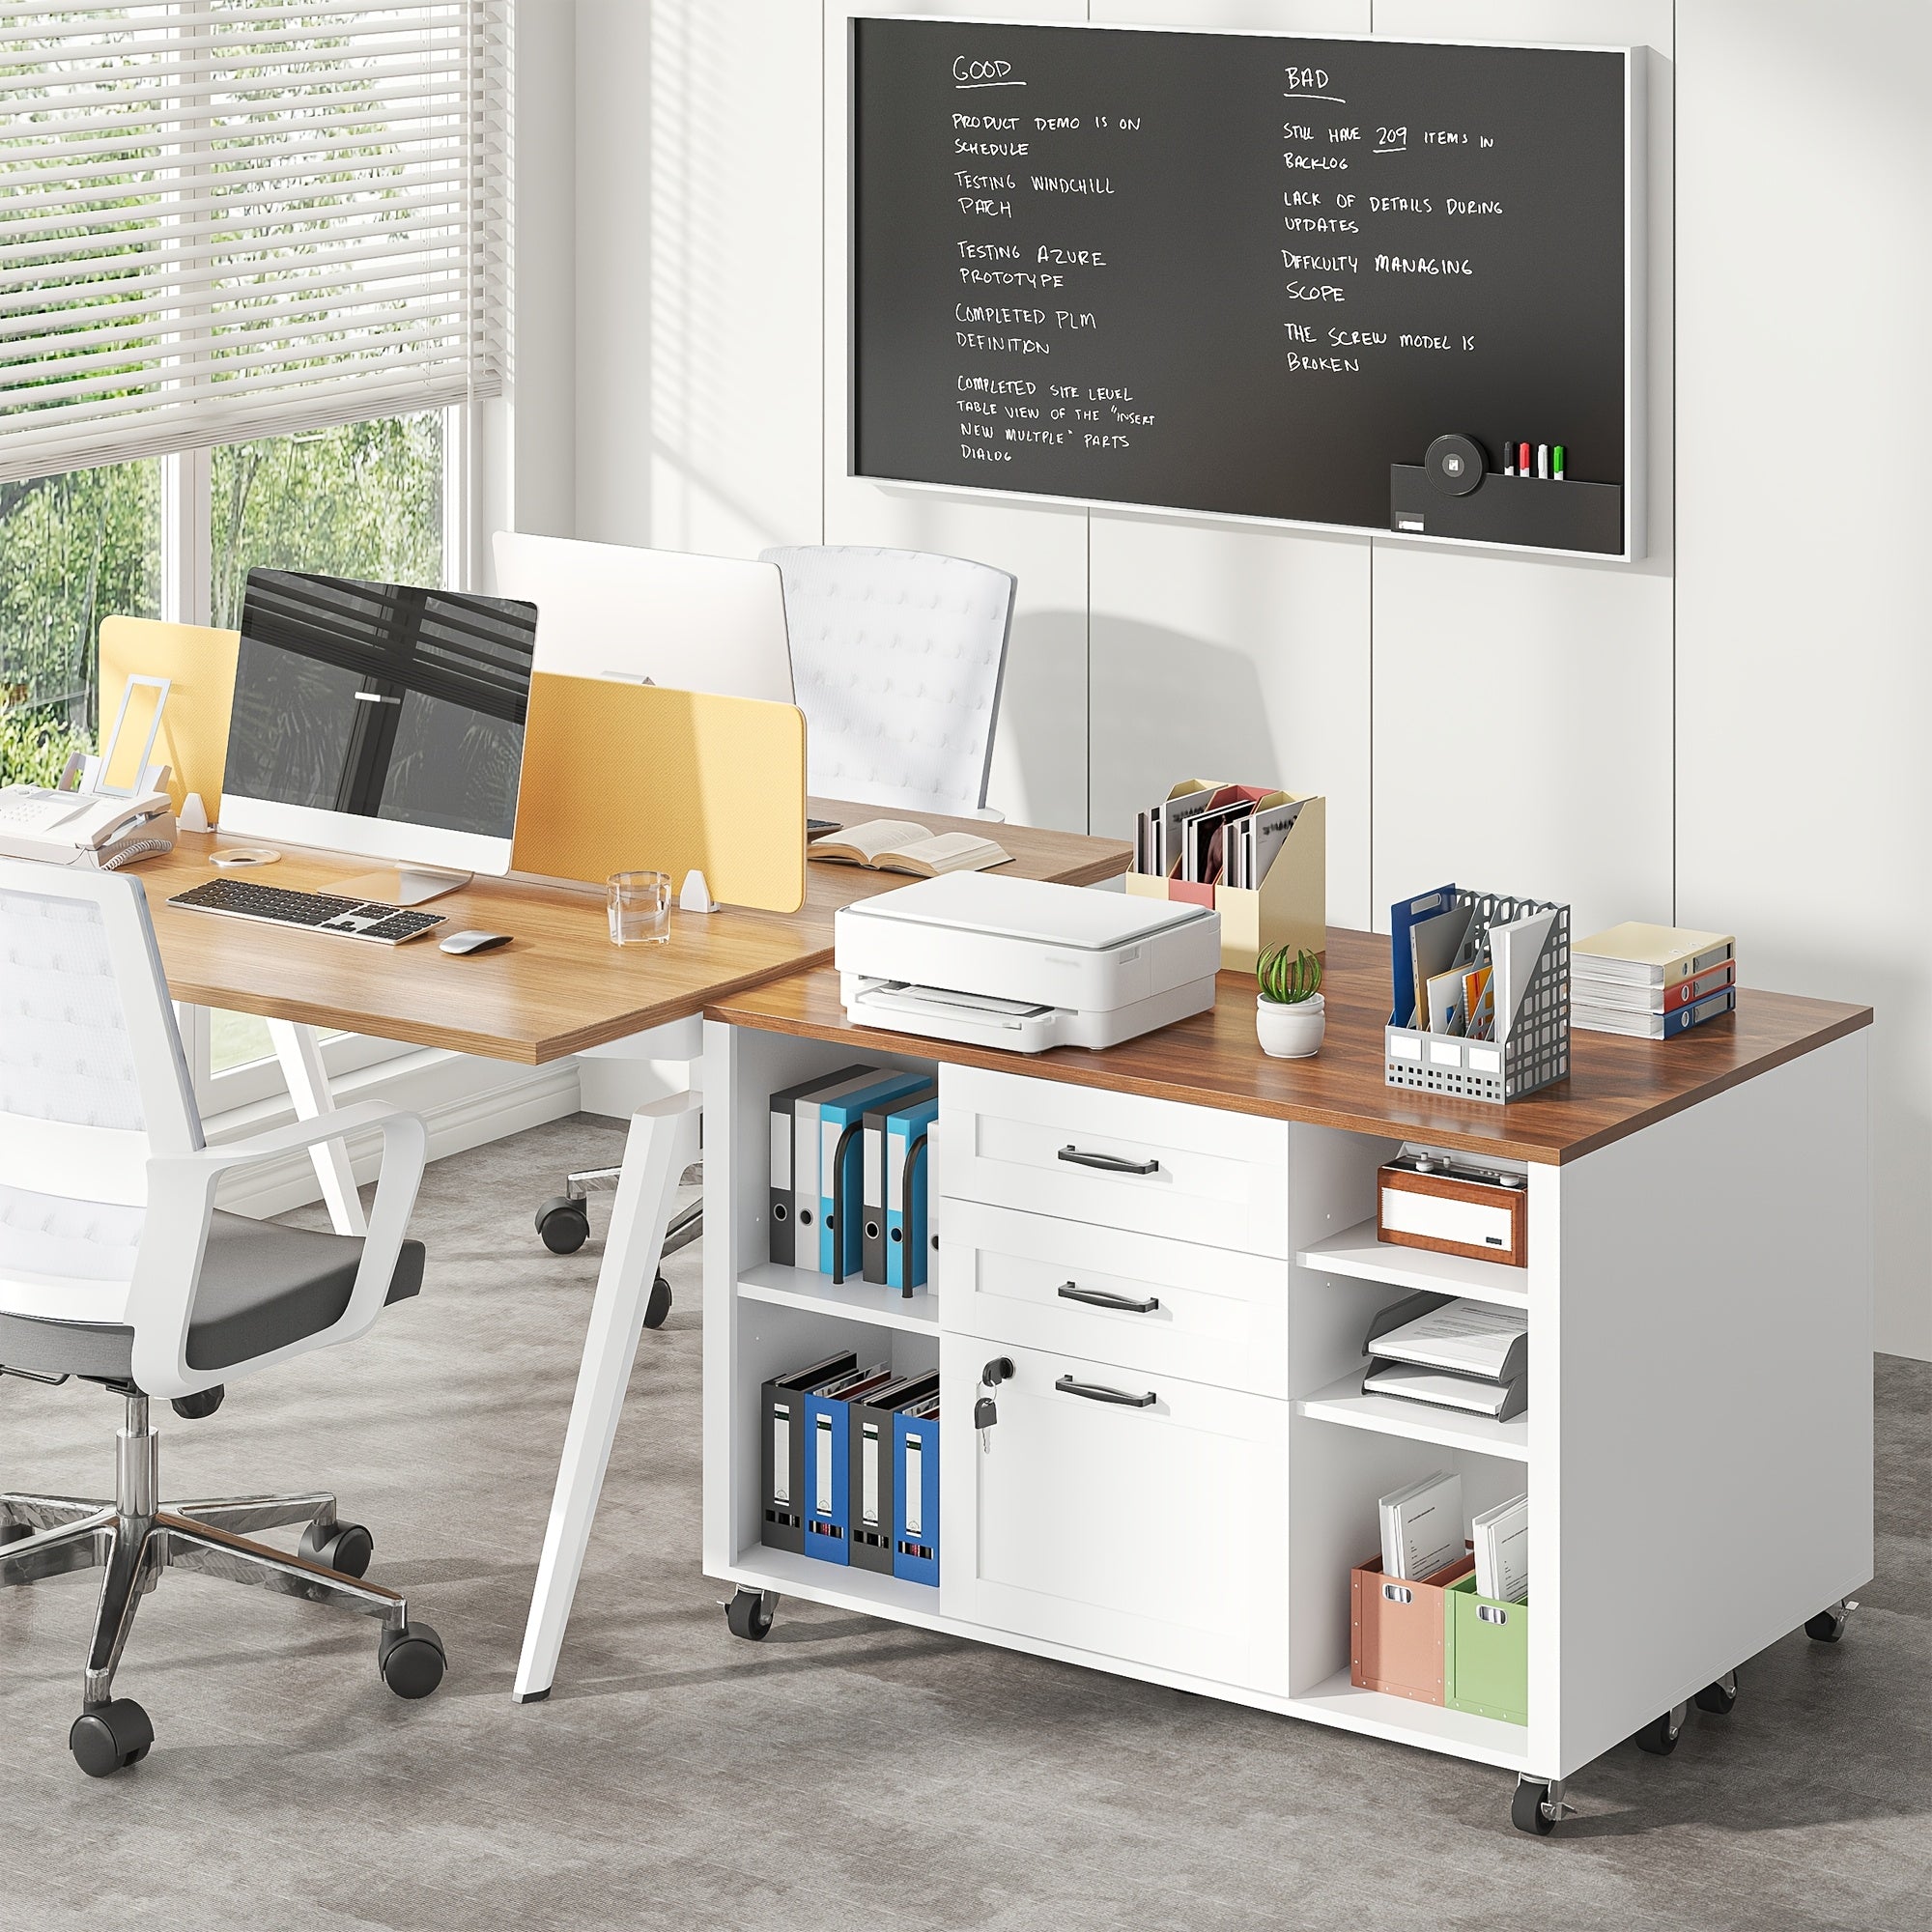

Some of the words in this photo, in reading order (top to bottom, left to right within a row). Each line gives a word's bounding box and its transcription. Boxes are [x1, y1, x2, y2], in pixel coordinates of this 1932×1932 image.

[952, 55, 1011, 81] GOOD
[1284, 67, 1329, 90] BAD
[952, 113, 1020, 131] PRODUCT
[1034, 117, 1080, 131] DEMO
[1094, 116, 1108, 128] IS
[1119, 117, 1141, 130] ON
[954, 137, 1030, 156] SCHEDULE
[1327, 127, 1362, 144] HAVE
[1376, 126, 1407, 146] 209
[1424, 130, 1468, 145] ITEMS
[1480, 135, 1494, 149] IN
[1283, 152, 1349, 170] BACKLOG
[953, 170, 1016, 191] TESTING
[1030, 175, 1115, 195] WINDCHILL
[957, 196, 1012, 218] PATCH
[1284, 190, 1321, 207] LACK
[1336, 193, 1356, 209] OF
[1369, 196, 1433, 213] DETAILS
[1446, 198, 1503, 215] DURING
[1284, 216, 1359, 234] UPDATES
[956, 240, 1021, 261] TESTING
[1037, 244, 1107, 267] AZURE
[1374, 253, 1473, 275] MANAGING
[959, 268, 1065, 289] PROTOTYPE
[1286, 280, 1346, 302] SCOPE
[955, 302, 1046, 325] COMPLETED
[1055, 310, 1097, 329] PLM
[955, 331, 1050, 355] DEFINITION
[1283, 323, 1318, 343] THE
[1327, 327, 1387, 347] SCREW
[1399, 333, 1452, 351] MODEL
[1462, 335, 1475, 351] IS
[1287, 352, 1359, 373] BROKEN
[957, 375, 1037, 396] COMPLETED
[1049, 384, 1080, 399] SITE
[1088, 386, 1134, 402] LEVEL
[955, 399, 998, 416] TABLE
[1004, 406, 1039, 419] VIEW
[1050, 407, 1066, 420] OF
[1074, 409, 1100, 421] THE
[960, 422, 994, 440] NEW
[1083, 433, 1130, 449] PARTS
[960, 443, 1012, 462] DIALOG
